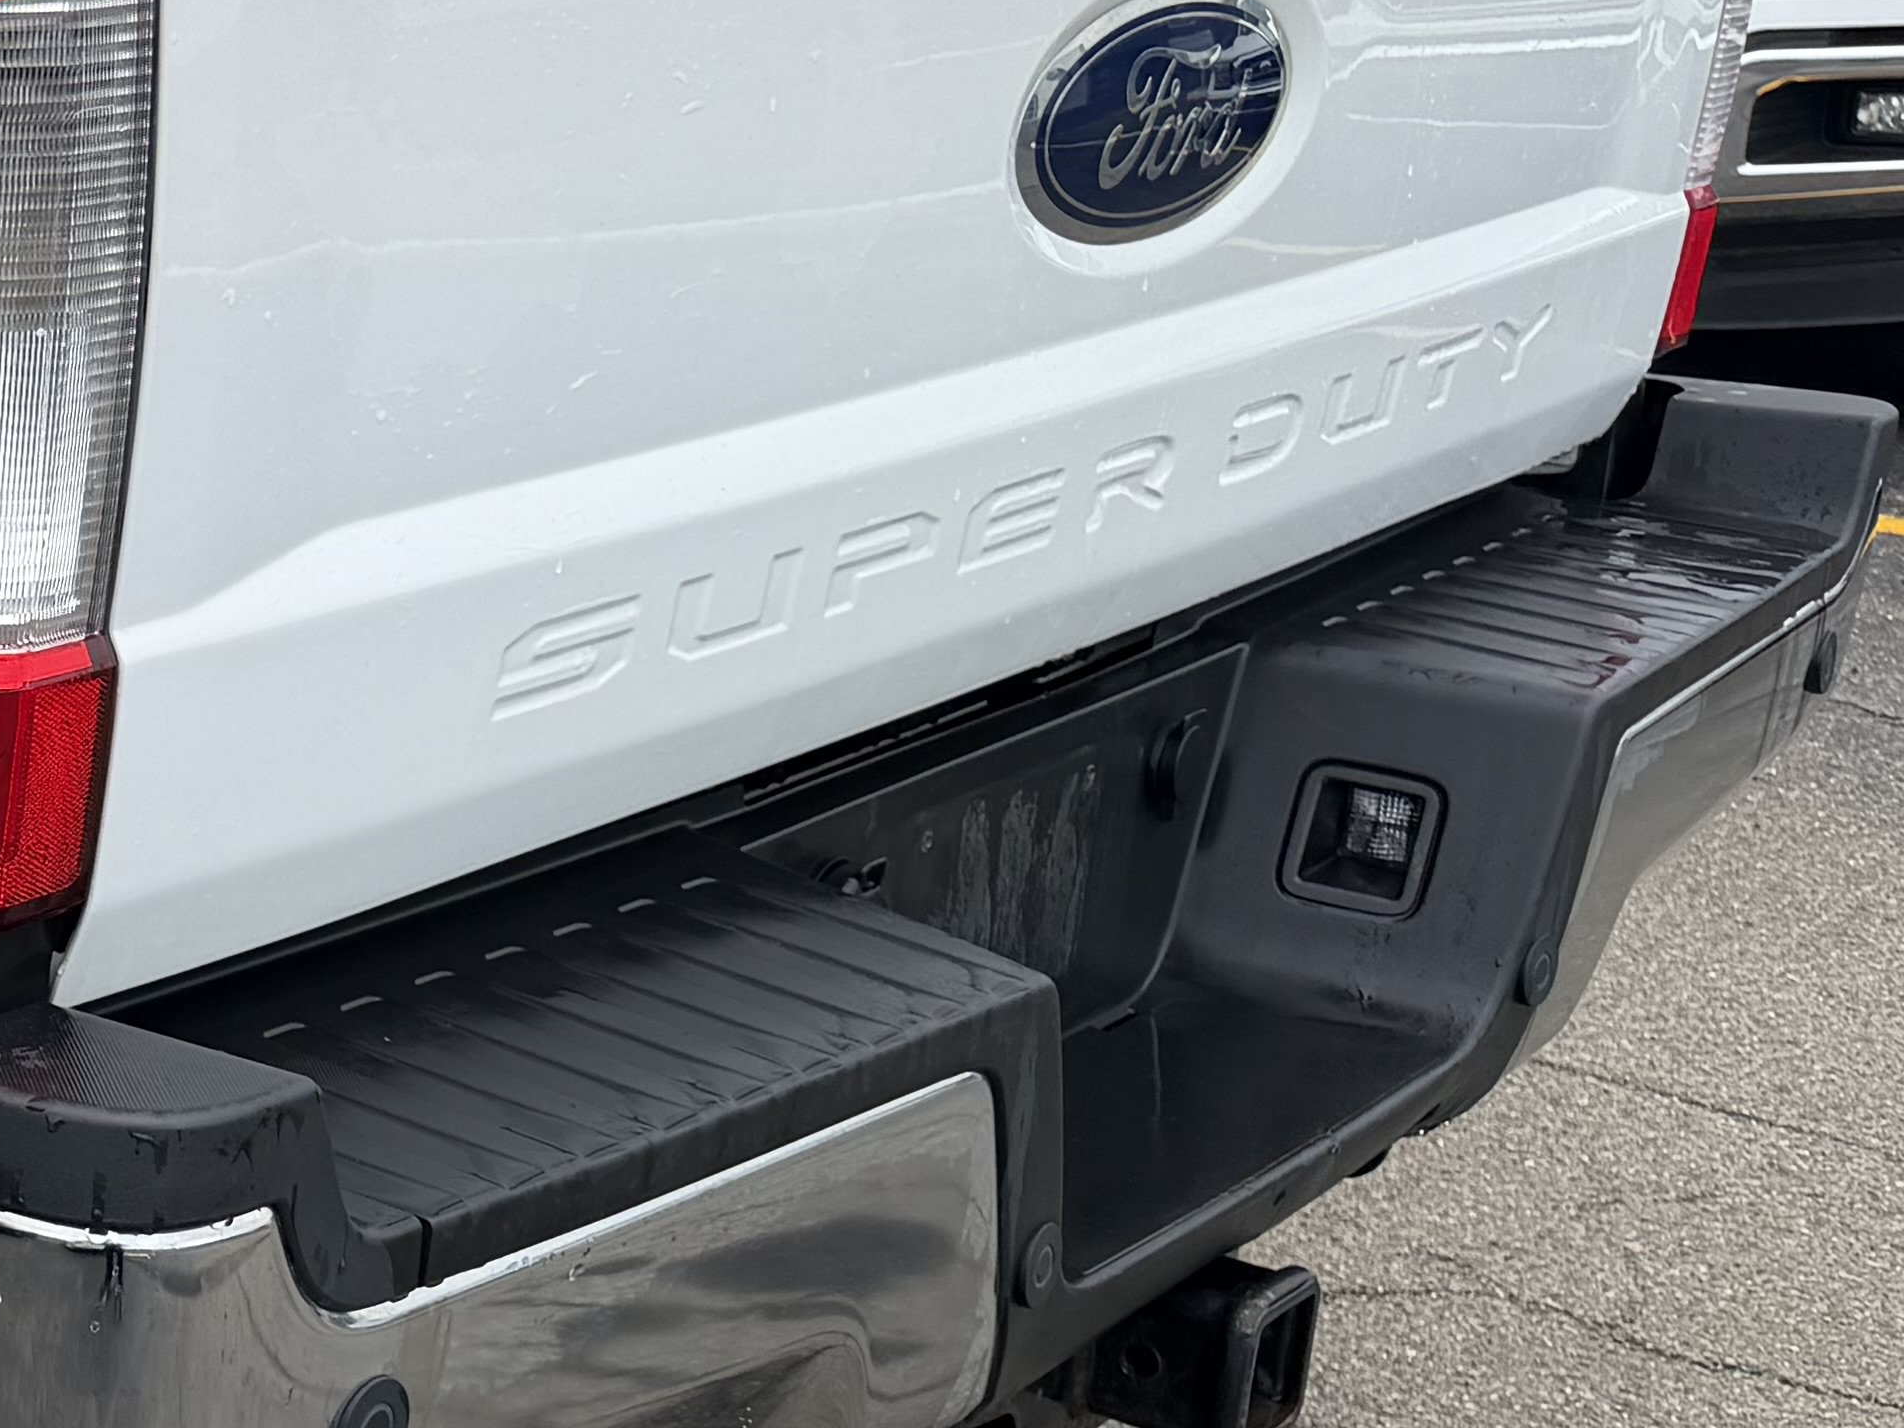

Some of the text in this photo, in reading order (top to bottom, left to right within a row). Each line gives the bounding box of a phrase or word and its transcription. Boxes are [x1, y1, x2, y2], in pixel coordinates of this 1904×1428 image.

[1098, 43, 1254, 190] Ford
[489, 303, 1554, 722] SUPER DUTY
